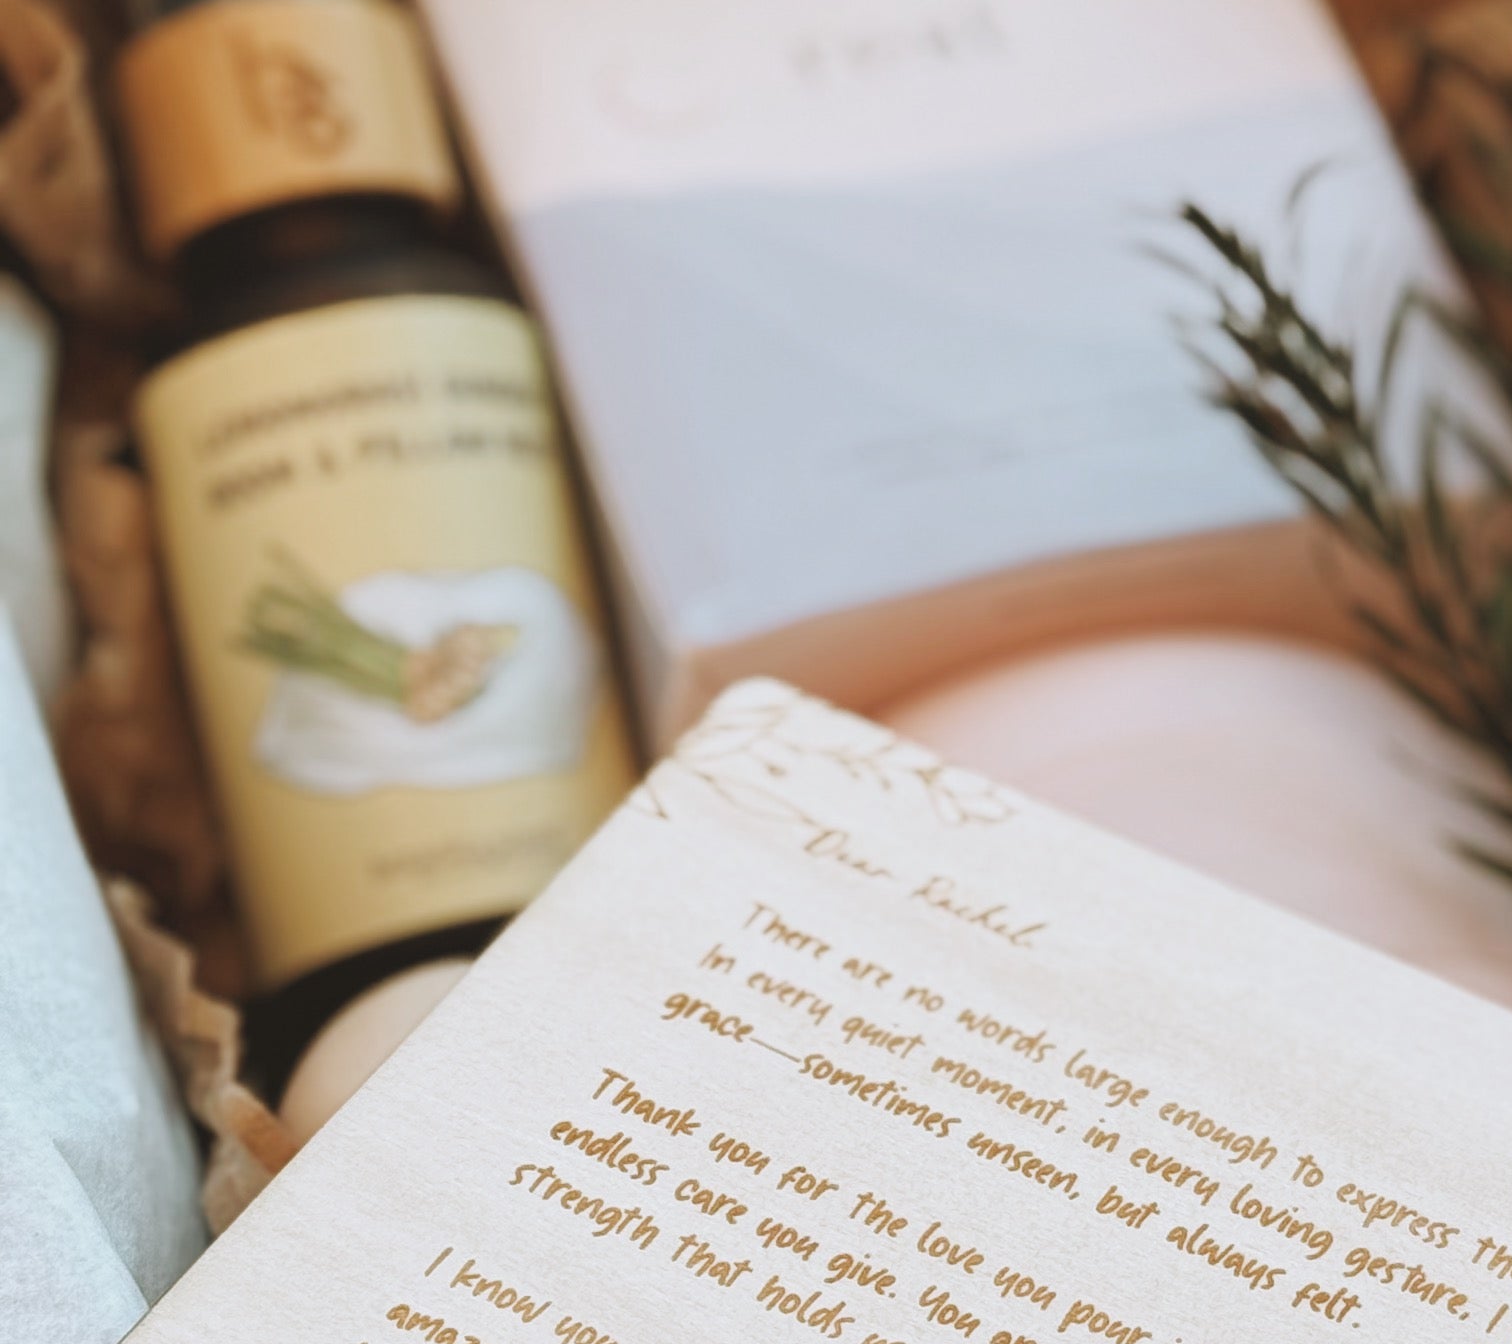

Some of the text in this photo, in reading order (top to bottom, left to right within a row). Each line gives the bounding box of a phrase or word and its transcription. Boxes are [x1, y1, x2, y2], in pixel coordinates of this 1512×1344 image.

[803, 828, 892, 879] Dear
[699, 944, 735, 973] In
[745, 971, 832, 1024] every
[841, 1015, 924, 1057] quiet
[931, 1056, 1067, 1132] moment,
[1082, 1118, 1120, 1152] in
[1128, 1147, 1220, 1205] every
[1228, 1183, 1334, 1260] loving
[1486, 1303, 1508, 1333] I
[747, 901, 830, 959] There
[842, 956, 892, 987] are
[903, 986, 943, 1012] no
[957, 1008, 1054, 1063] words
[1063, 1049, 1150, 1108] large
[1158, 1102, 1277, 1168] enough
[1291, 1153, 1324, 1188] to
[1336, 1183, 1459, 1247] express
[424, 1248, 452, 1276] I
[449, 1258, 550, 1323] know
[508, 1163, 660, 1250] strength
[672, 1233, 751, 1287] that
[756, 1274, 854, 1338] holds
[549, 1120, 668, 1185] endless
[674, 1178, 748, 1224] care
[755, 1217, 820, 1261] you
[824, 1252, 896, 1298] give.
[918, 1285, 981, 1338] You
[592, 1067, 700, 1135] Thank
[707, 1131, 771, 1175] you
[776, 1164, 839, 1200] for
[849, 1191, 909, 1238] the
[916, 1220, 985, 1274] love
[993, 1266, 1056, 1310] you
[966, 1131, 1079, 1199] unseen,
[1095, 1185, 1159, 1229] but
[1167, 1223, 1285, 1290] always
[1290, 1281, 1360, 1327] felt.
